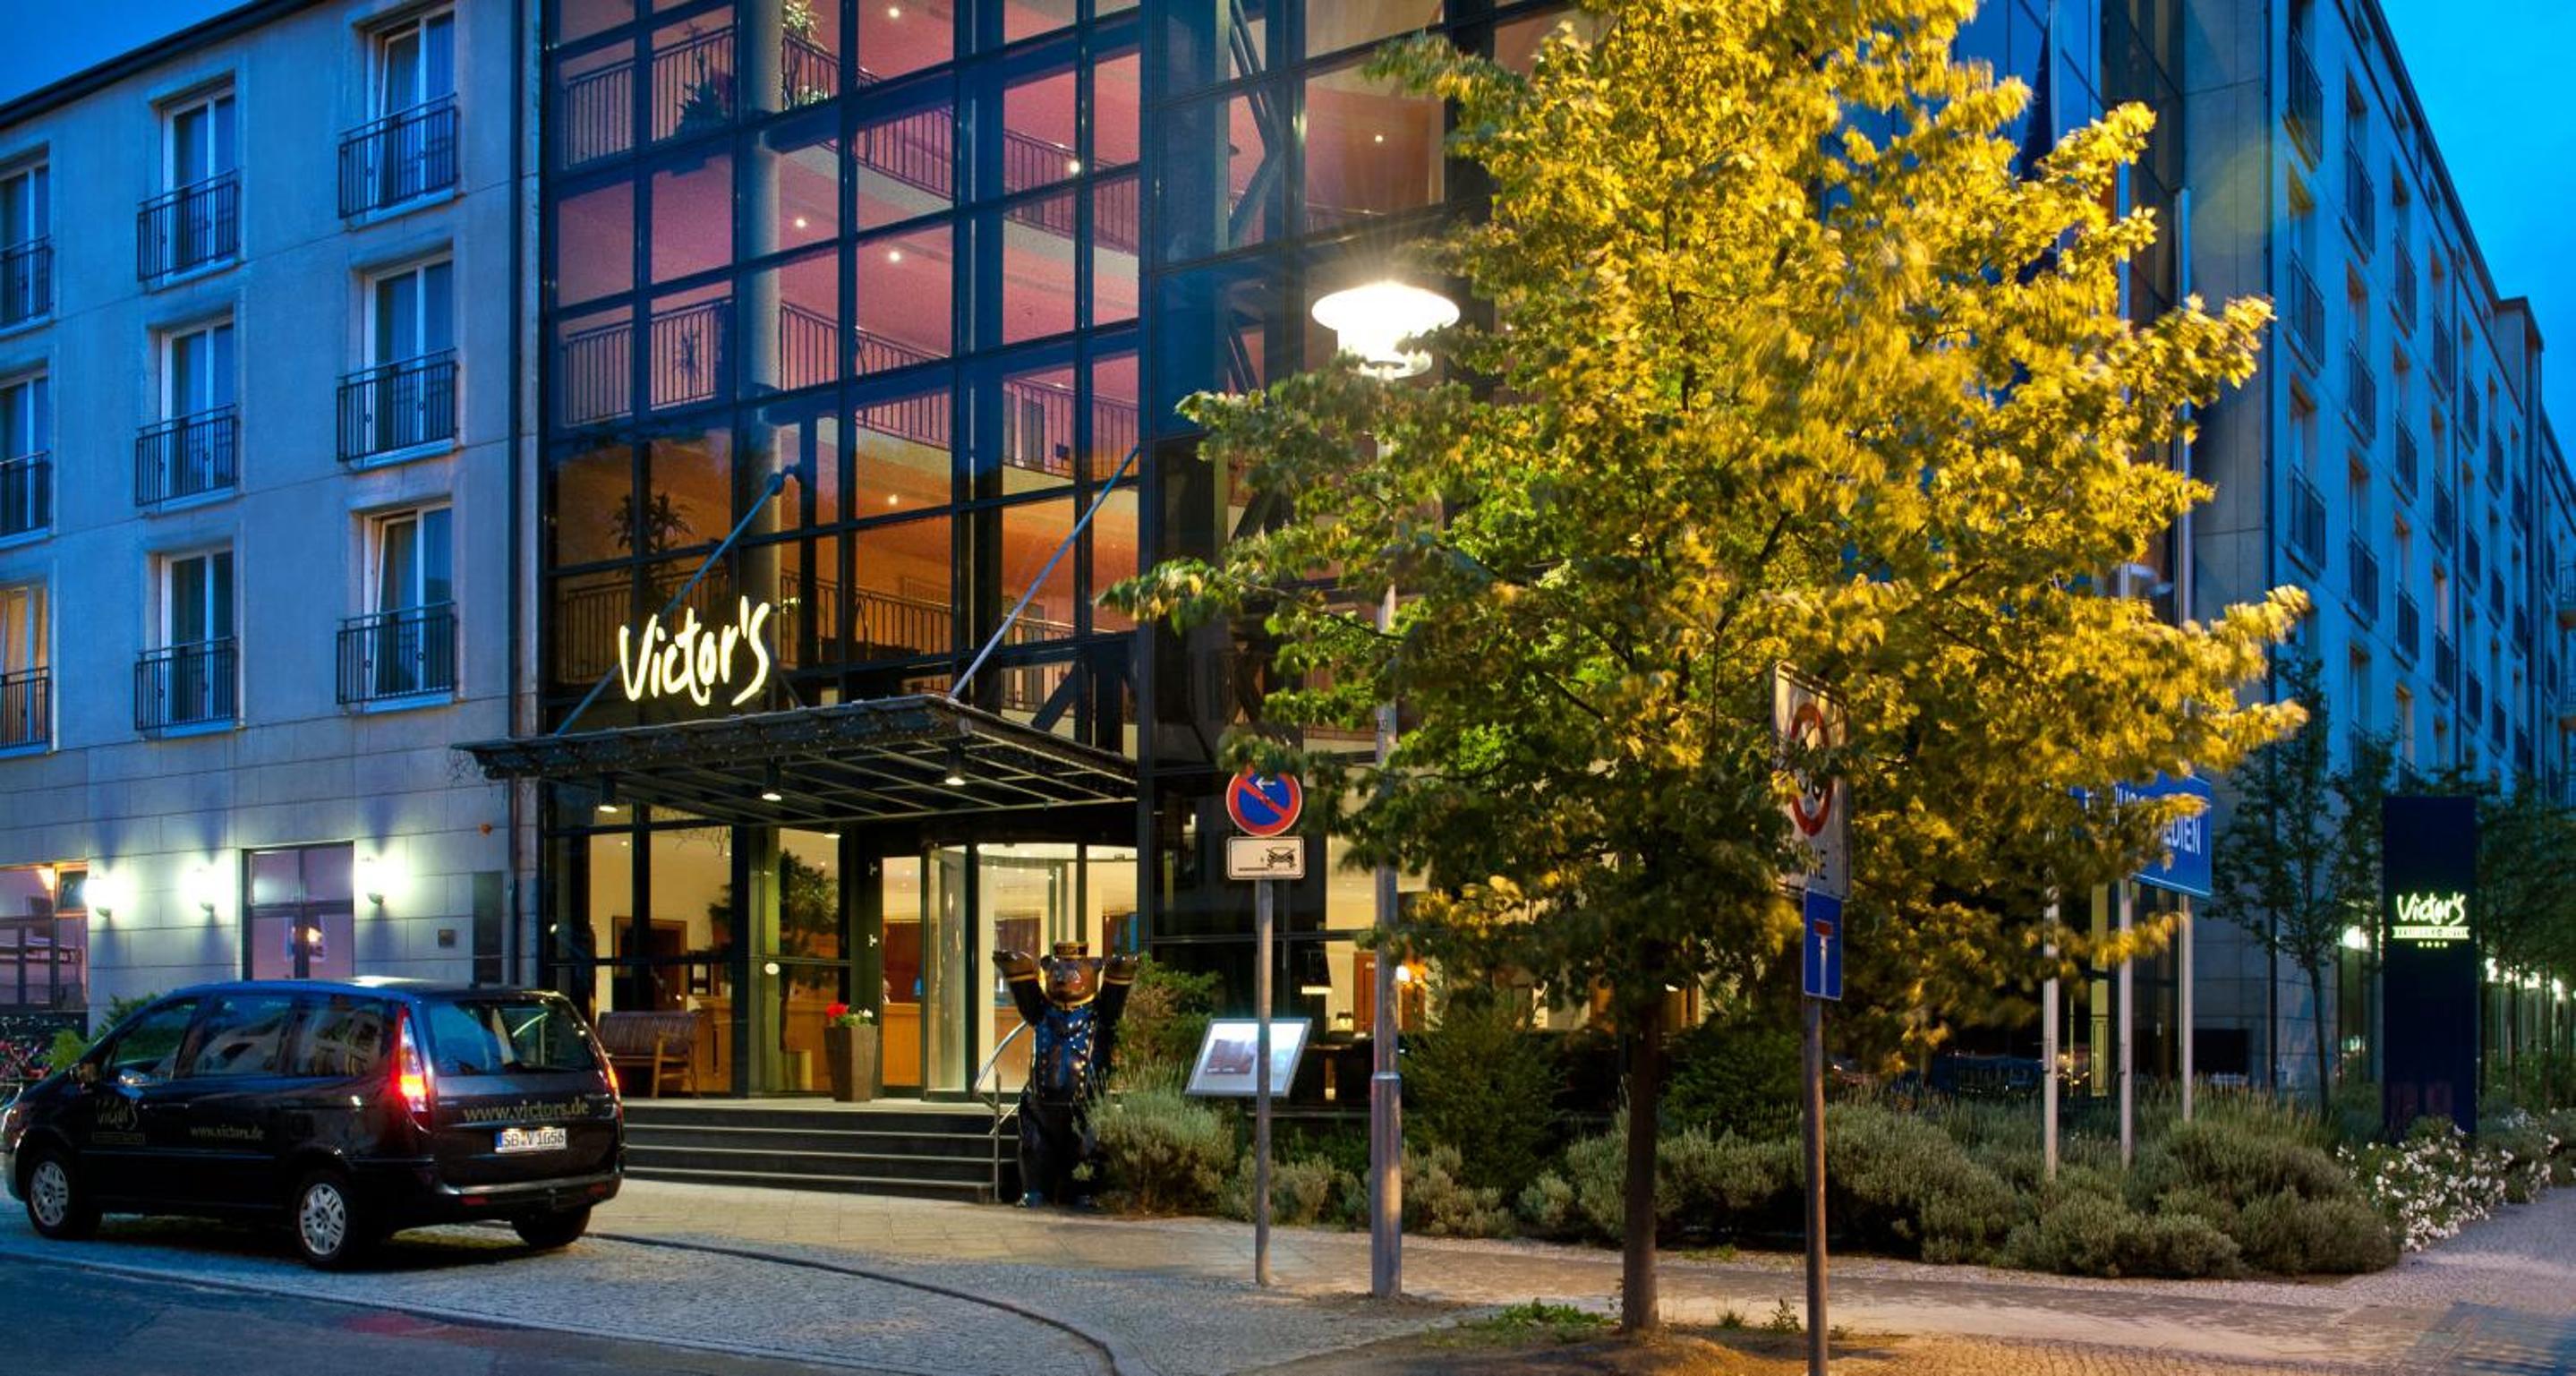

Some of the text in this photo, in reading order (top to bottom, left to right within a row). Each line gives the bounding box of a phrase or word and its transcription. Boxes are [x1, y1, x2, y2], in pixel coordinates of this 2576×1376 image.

[618, 594, 771, 707] Victor's
[2160, 815, 2201, 856] EDIEN
[2396, 891, 2467, 927] Victor's
[463, 1097, 590, 1122] www.victors.de
[188, 1122, 266, 1141] www.victors.de
